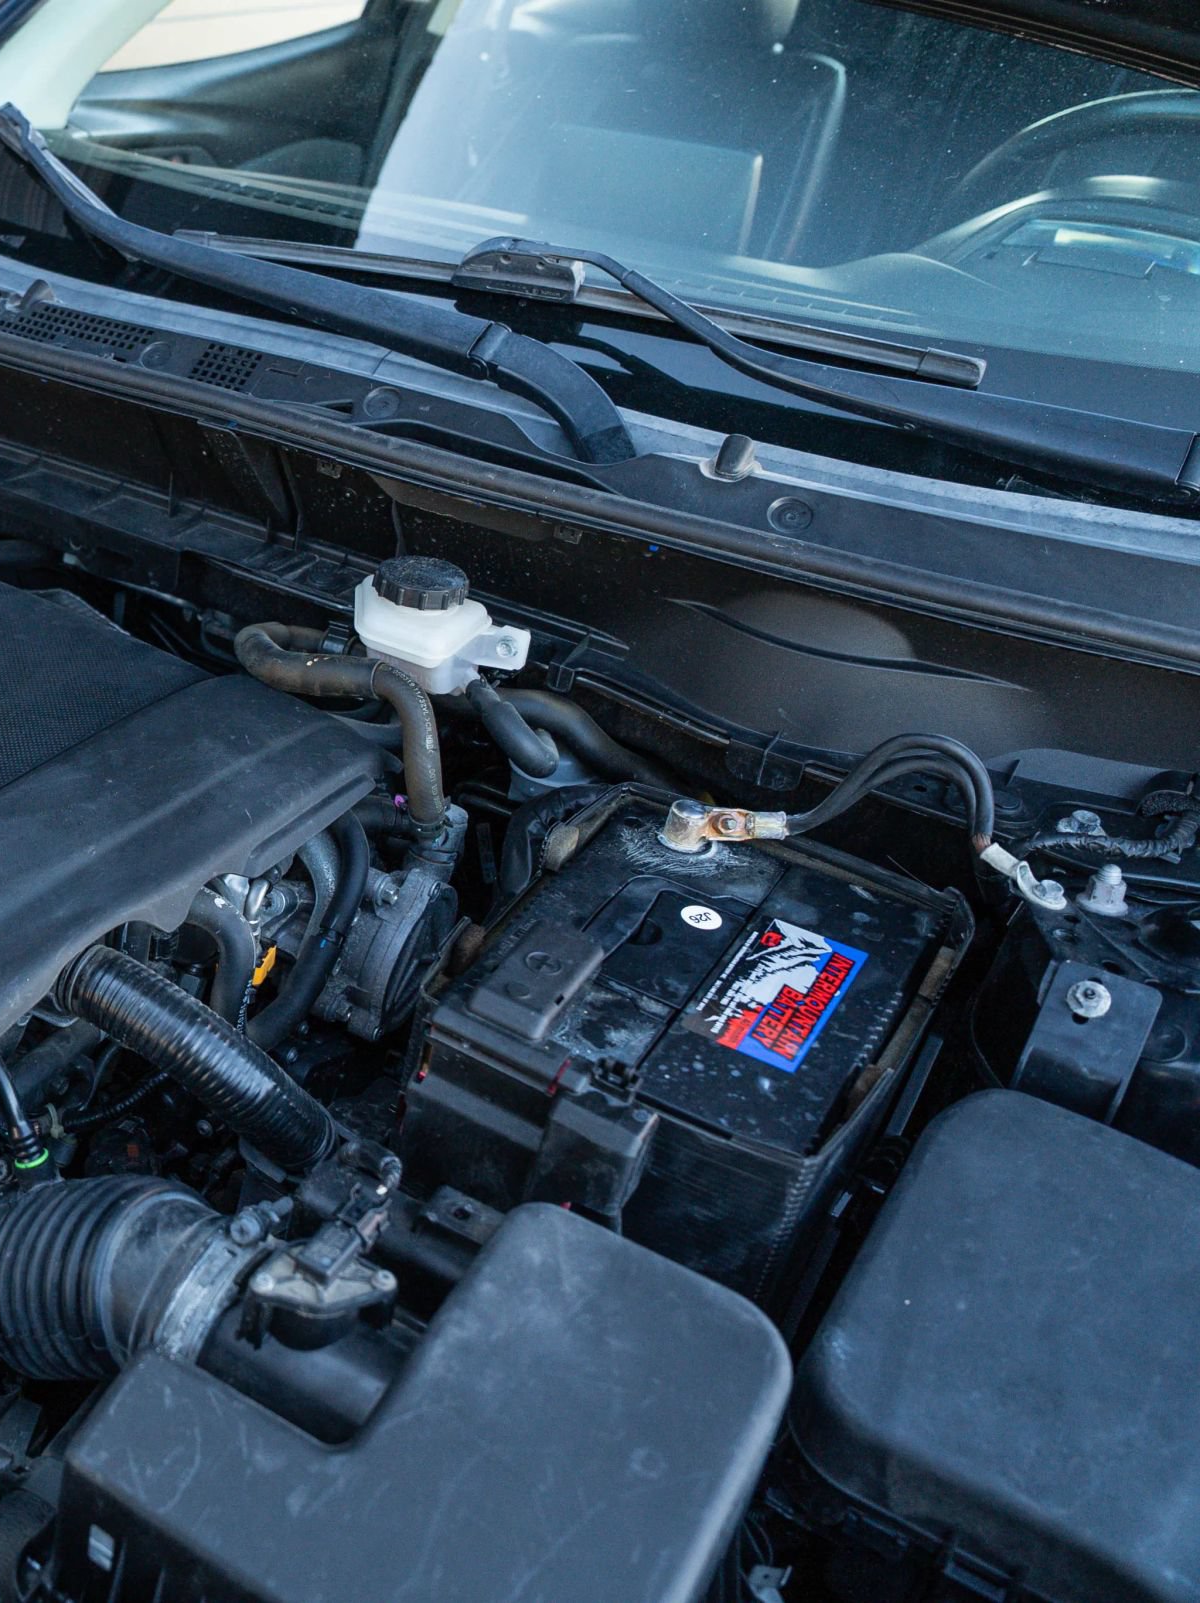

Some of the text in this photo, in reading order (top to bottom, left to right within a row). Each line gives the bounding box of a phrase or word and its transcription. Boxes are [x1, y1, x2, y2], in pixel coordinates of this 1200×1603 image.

[689, 912, 712, 924] J26
[751, 984, 805, 1049] BATTERY
[771, 952, 856, 1061] INTERMOUNTAIN
